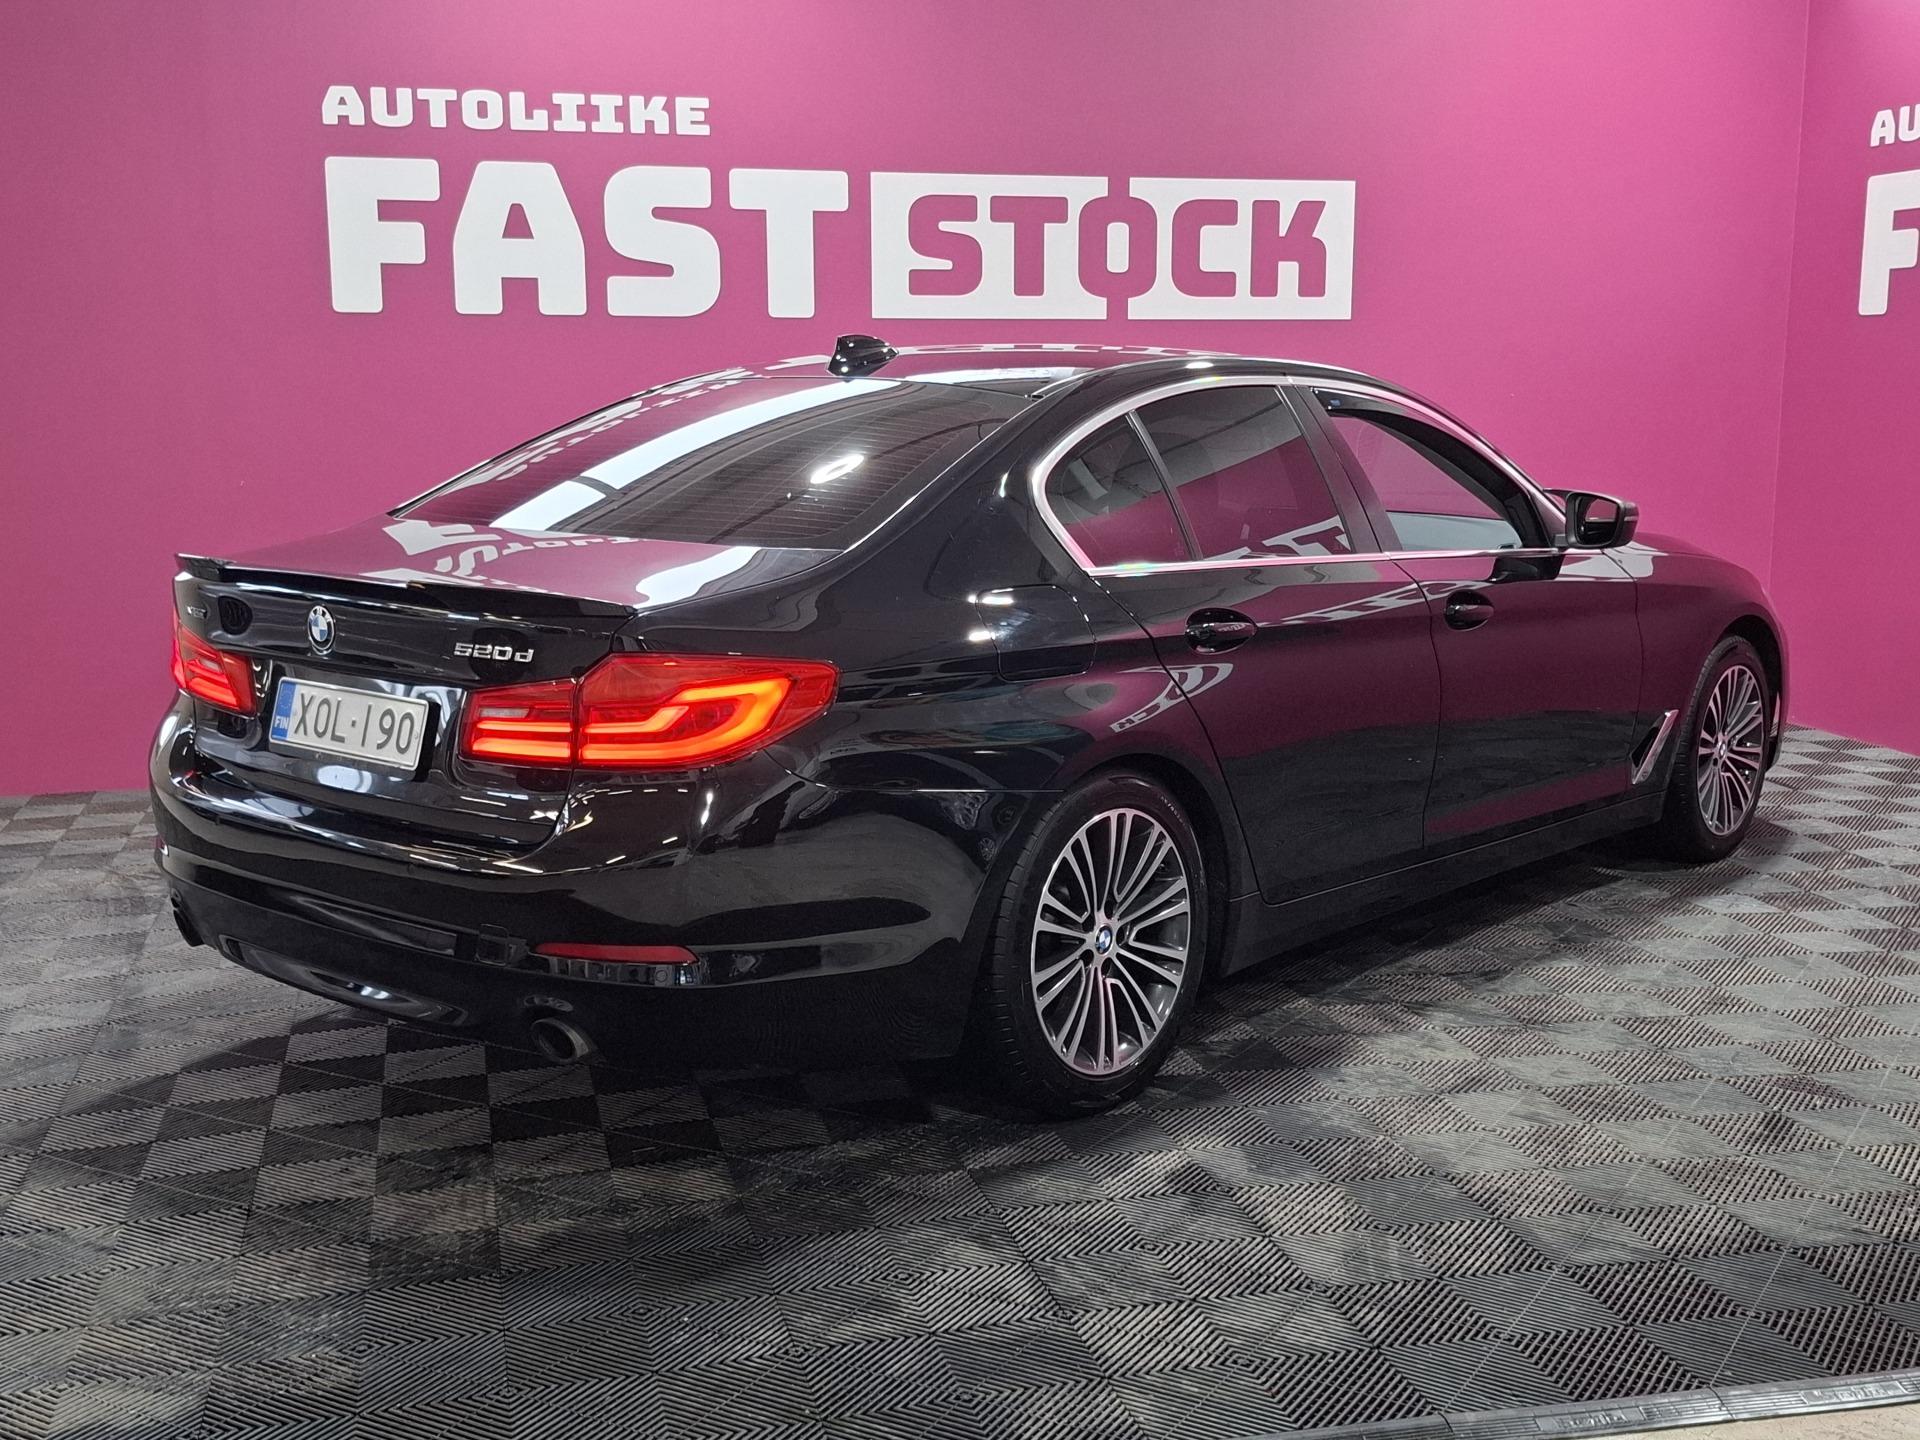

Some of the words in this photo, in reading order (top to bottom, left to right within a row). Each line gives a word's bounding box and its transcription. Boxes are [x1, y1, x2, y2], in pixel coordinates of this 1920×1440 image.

[322, 85, 711, 136] AUTOLIIKE
[324, 155, 849, 318] FAST
[907, 193, 1328, 299] STOCK
[1858, 169, 1920, 316] F
[453, 642, 535, 663] 520d
[274, 716, 290, 730] FIN
[294, 692, 415, 755] XOL-190
